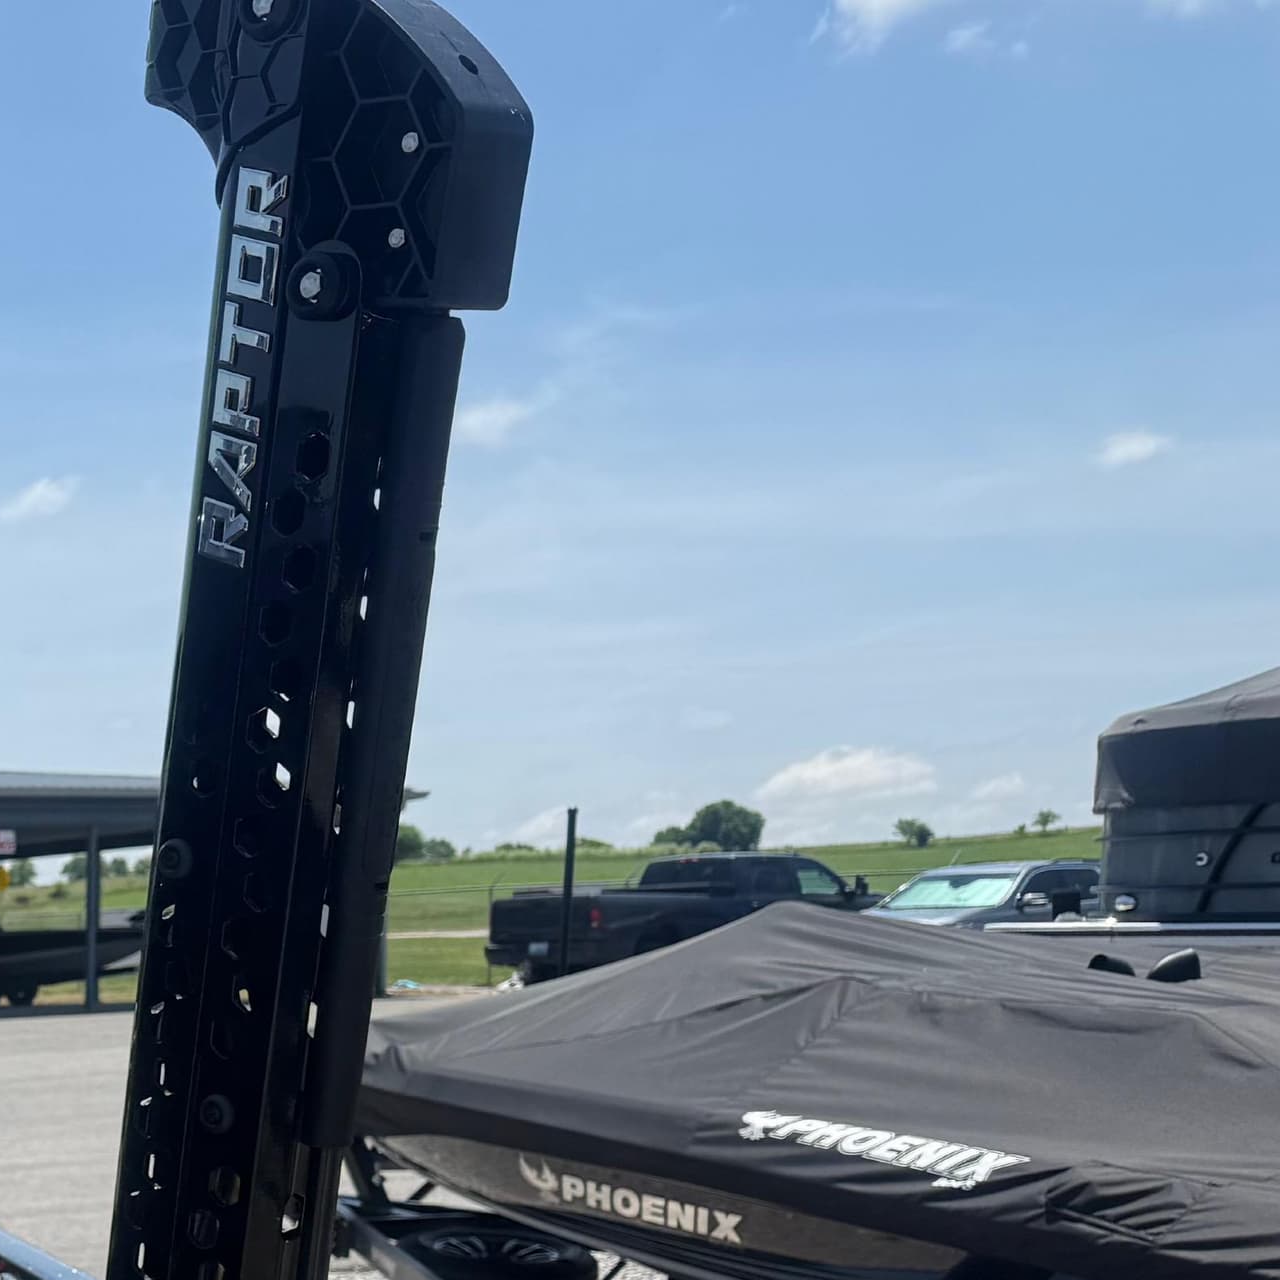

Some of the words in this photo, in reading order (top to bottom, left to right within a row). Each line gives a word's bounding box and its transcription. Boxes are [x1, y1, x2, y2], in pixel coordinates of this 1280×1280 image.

[198, 165, 289, 569] RAPTOR
[770, 1115, 1031, 1183] PHOENIX
[561, 1174, 743, 1245] PHOENIX
